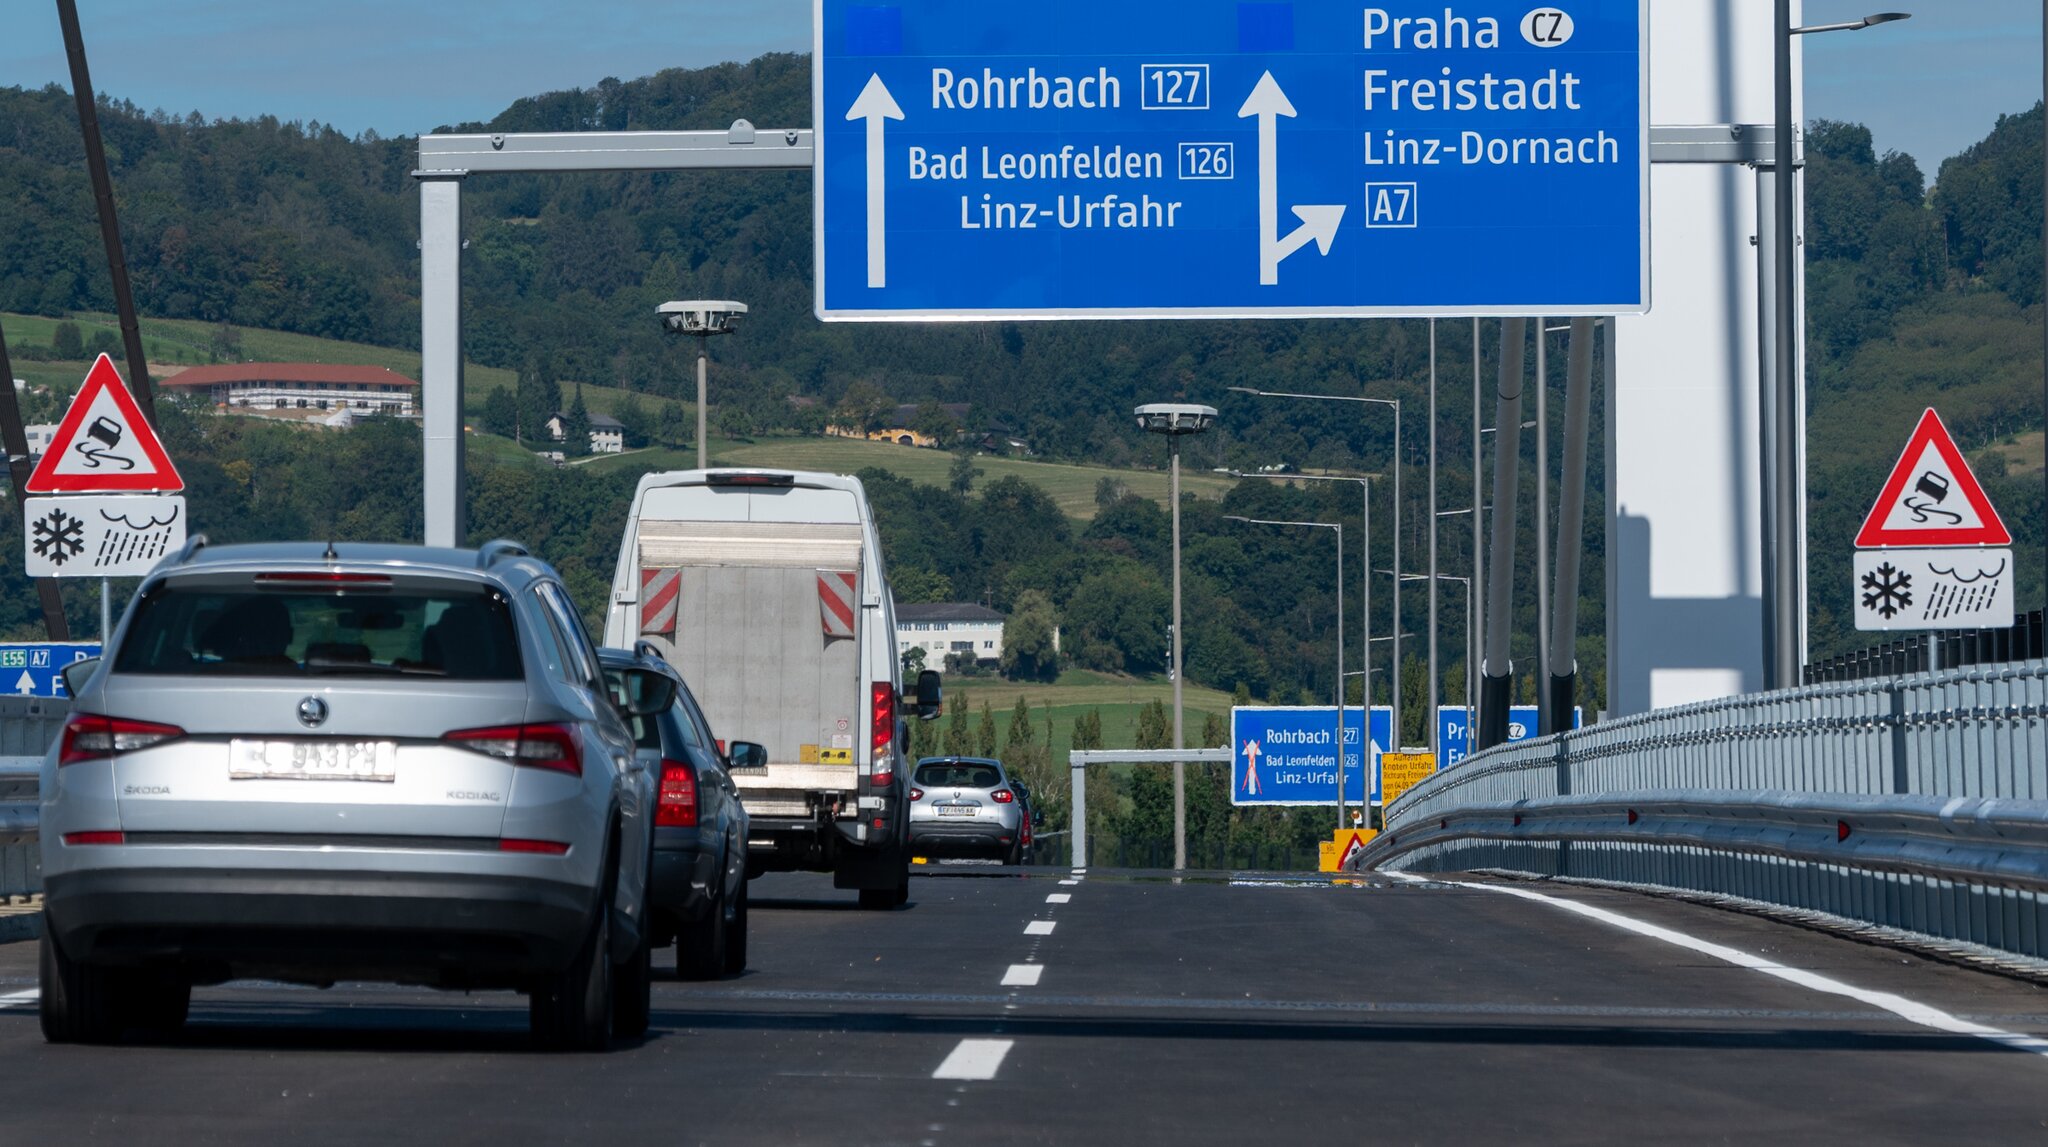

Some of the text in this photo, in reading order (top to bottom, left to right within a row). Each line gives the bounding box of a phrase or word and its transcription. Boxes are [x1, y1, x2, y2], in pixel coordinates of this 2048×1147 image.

[1363, 8, 1563, 49] Praha CZ
[931, 66, 1201, 109] Rohrbach 127
[1364, 66, 1582, 111] Freistadt
[909, 145, 1228, 180] Bad Leonfelden 126
[1364, 129, 1619, 165] Linz-Dornach
[960, 193, 1182, 229] Linz-Urfahr
[1373, 188, 1411, 222] A7
[2, 651, 48, 666] E55 A7
[1266, 729, 1356, 744] Rohrbach 27
[1266, 754, 1356, 767] Bad Leonfelden 26
